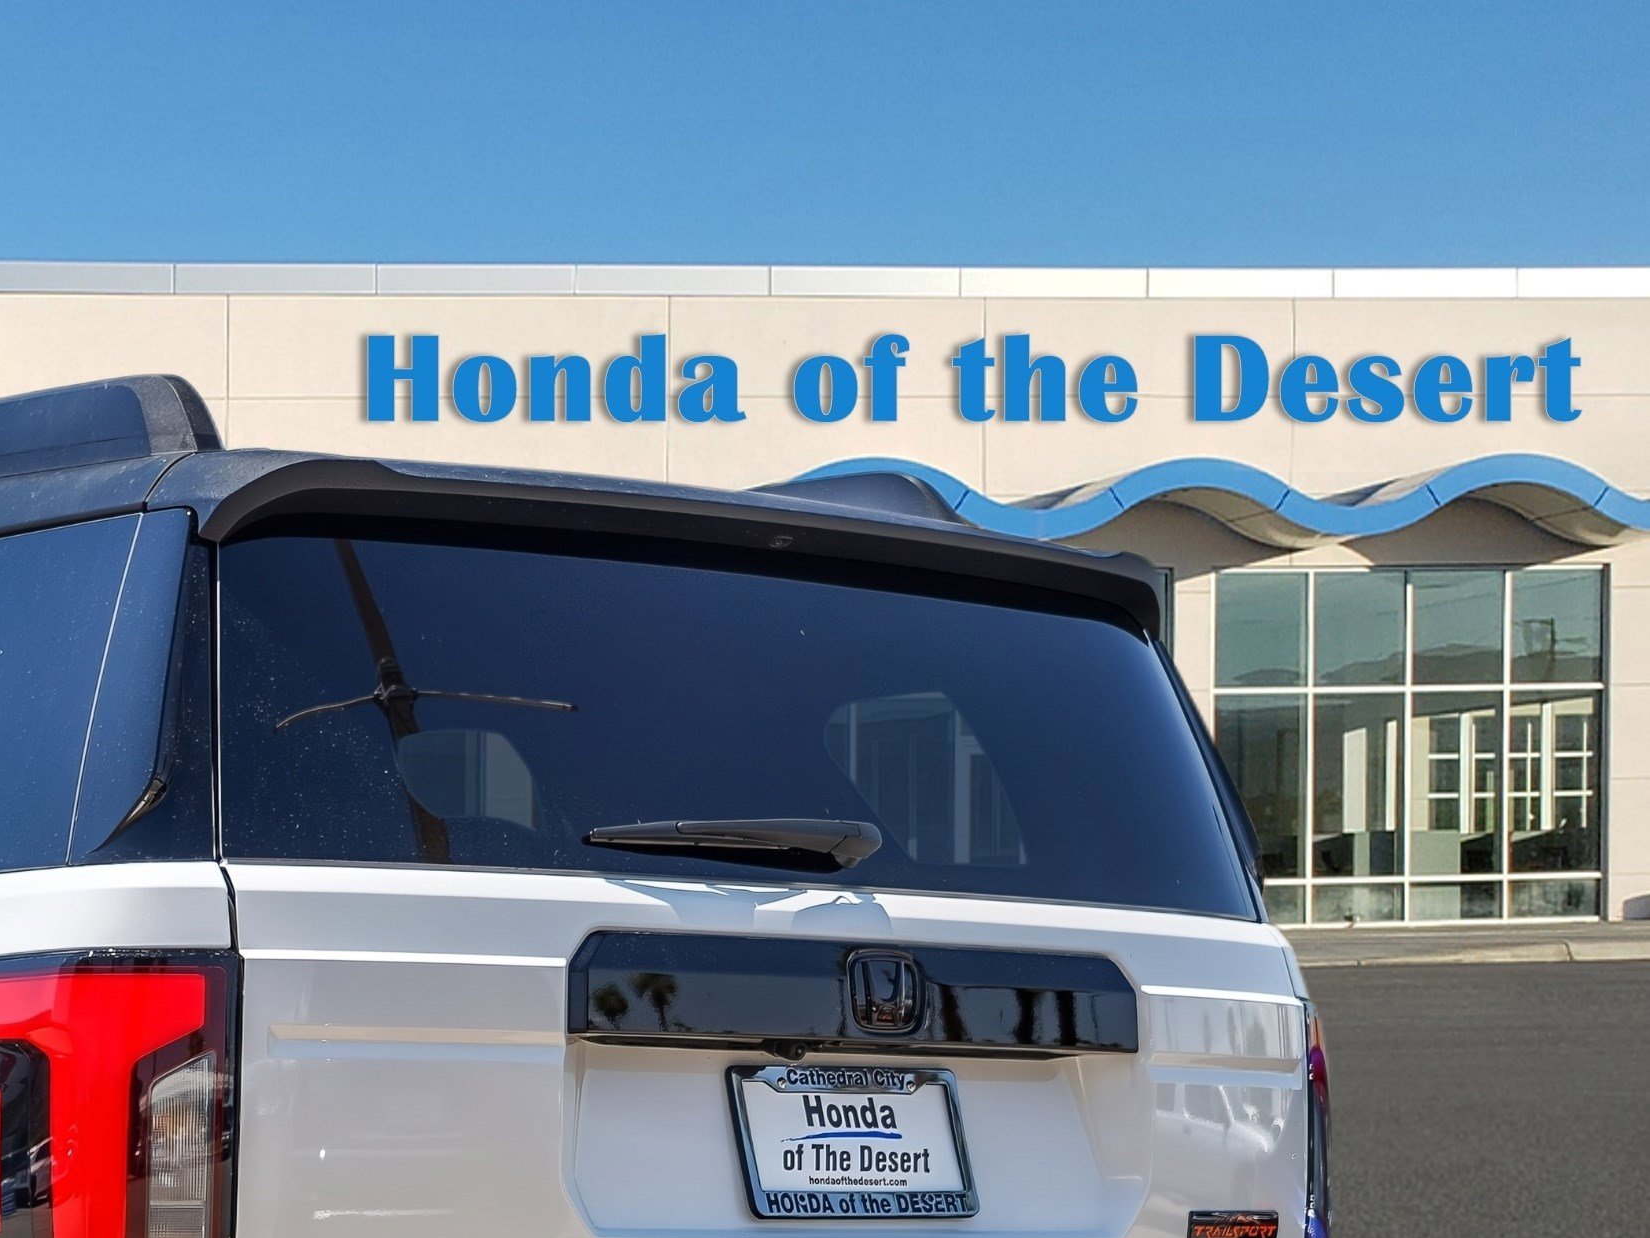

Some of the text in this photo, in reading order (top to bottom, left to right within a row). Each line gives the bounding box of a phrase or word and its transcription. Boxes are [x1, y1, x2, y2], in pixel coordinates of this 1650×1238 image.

[785, 1068, 906, 1089] Cathedral City
[803, 1095, 897, 1129] Honda
[783, 1144, 931, 1173] of The Desert
[809, 1176, 908, 1187] hondaofthedesert.com
[765, 1192, 968, 1214] HONDA of the DESERT
